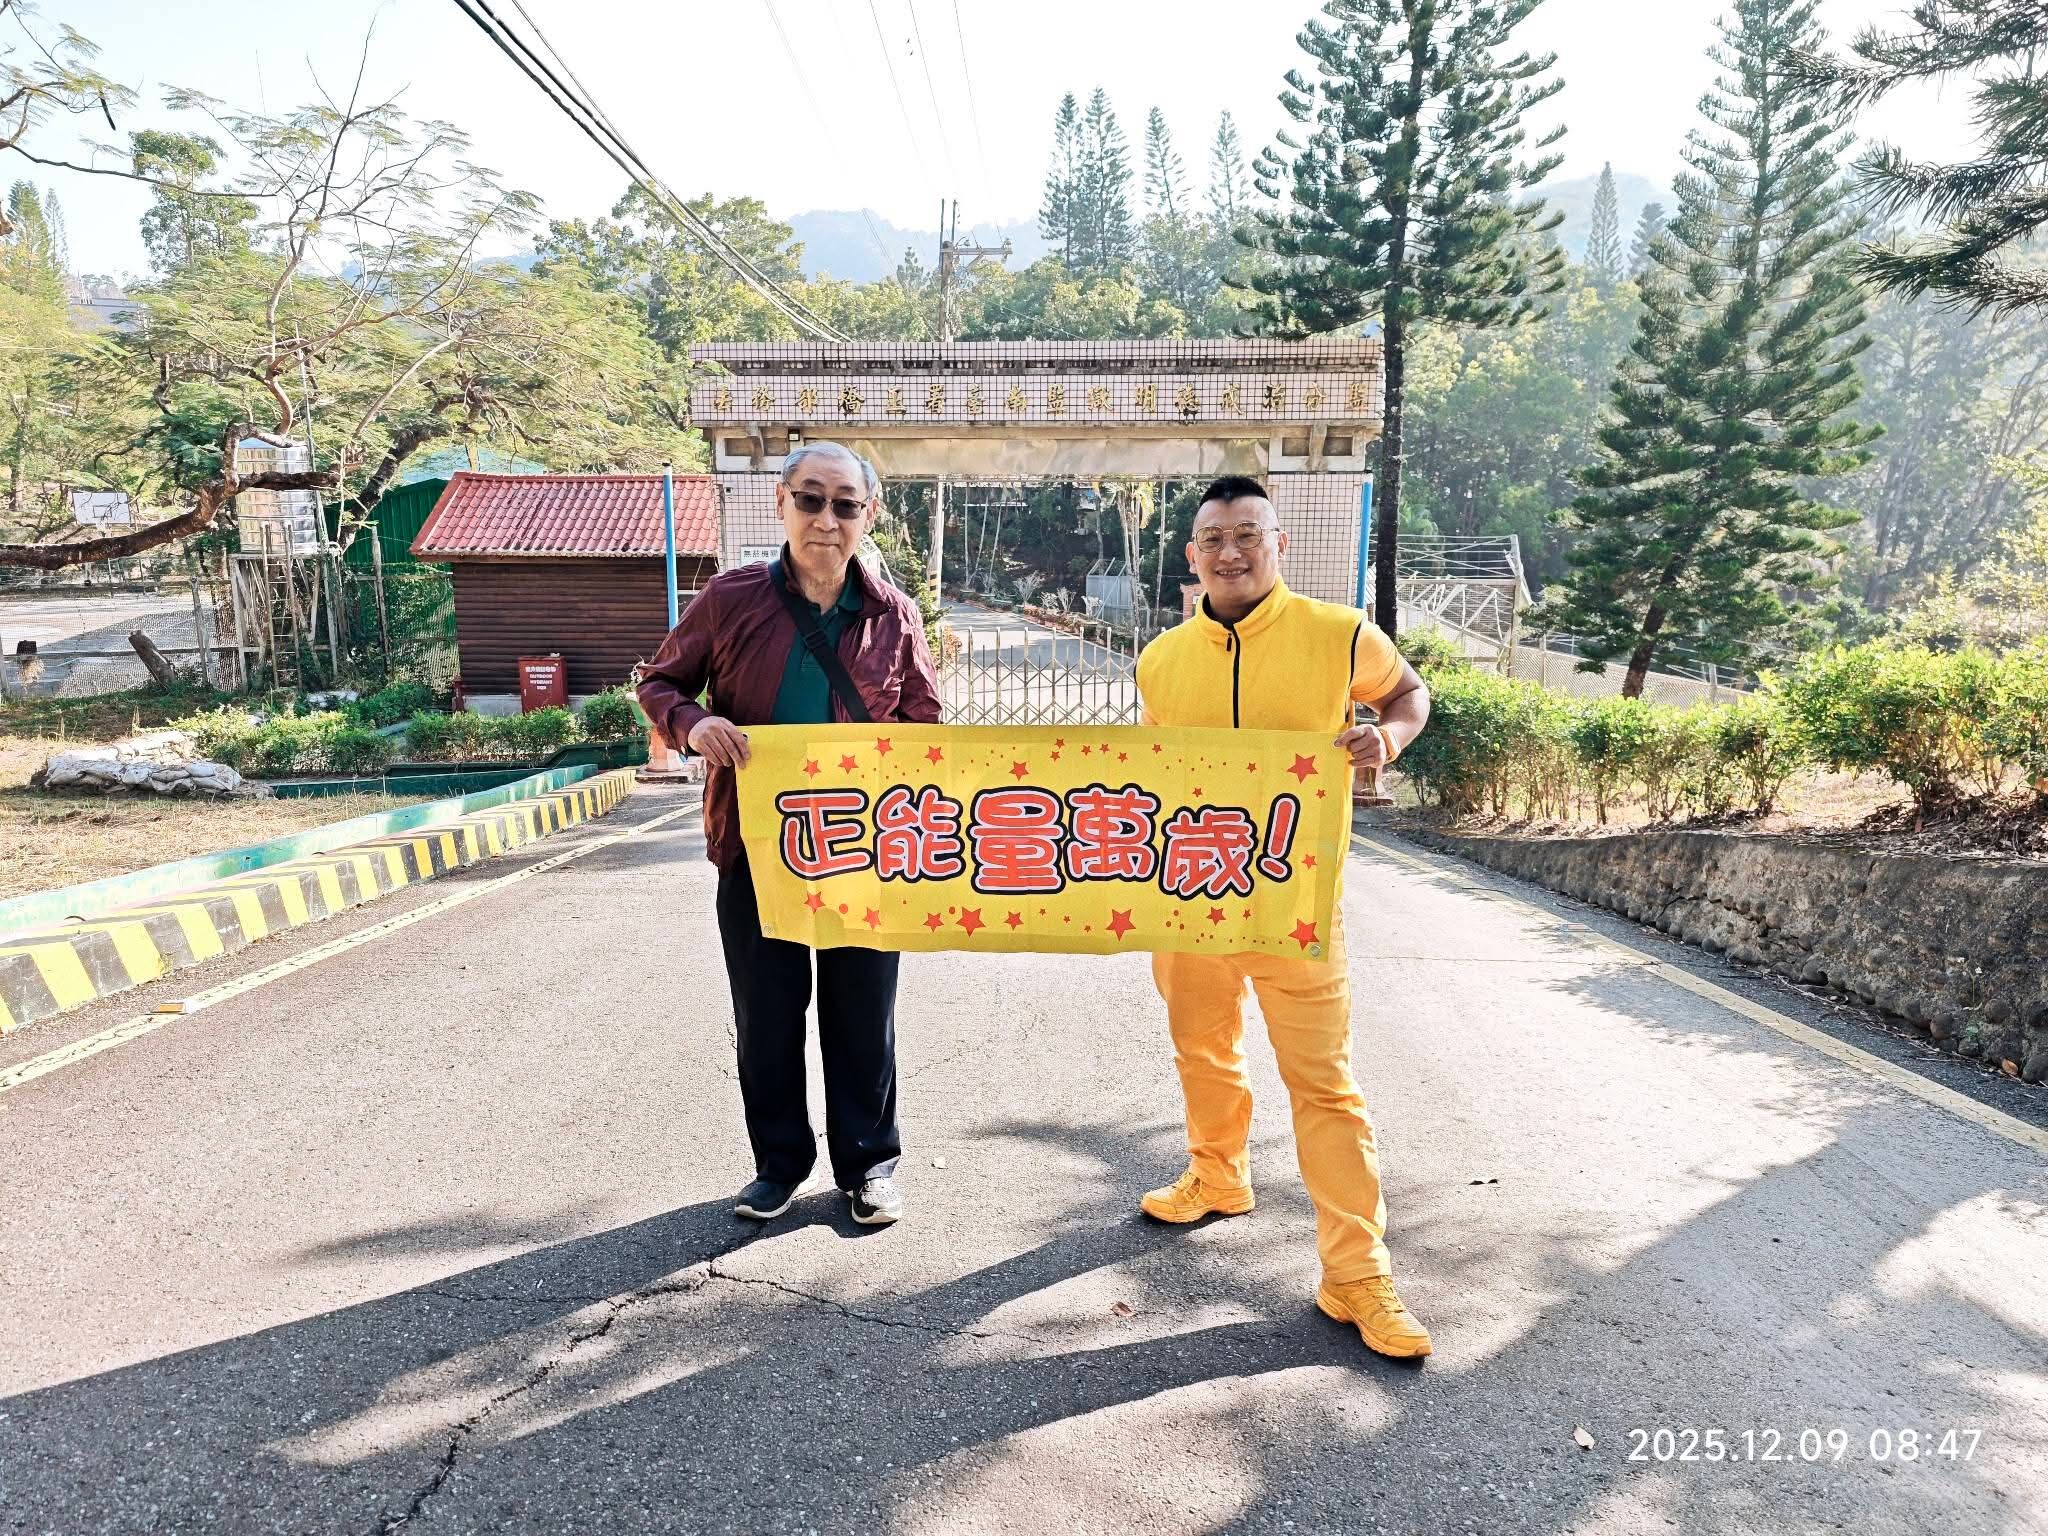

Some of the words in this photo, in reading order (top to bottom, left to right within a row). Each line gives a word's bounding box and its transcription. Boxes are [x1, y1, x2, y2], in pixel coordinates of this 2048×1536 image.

[775, 784, 1301, 900] 正能量萬歲!
